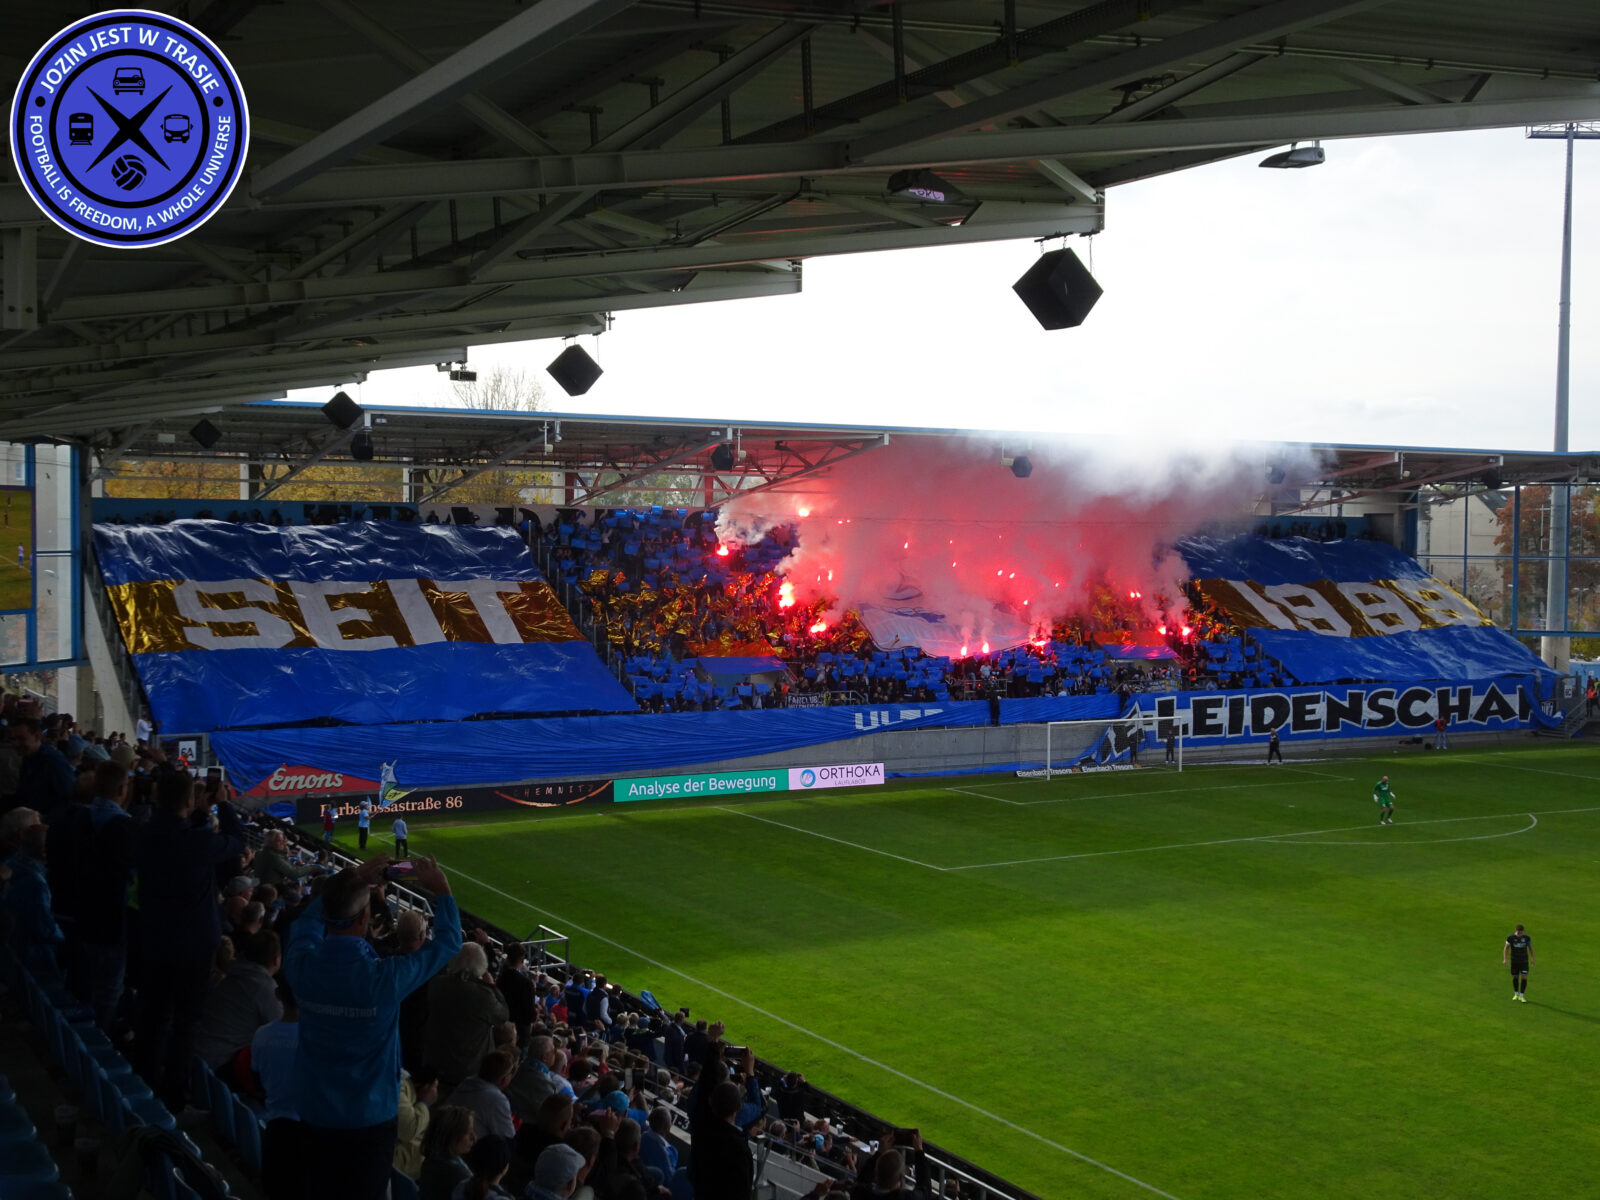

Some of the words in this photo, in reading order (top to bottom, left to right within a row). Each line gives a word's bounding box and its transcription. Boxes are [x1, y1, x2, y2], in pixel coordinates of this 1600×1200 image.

[173, 579, 525, 650] SEIT
[268, 768, 344, 791] Emons
[820, 765, 881, 780] ORTHOKA
[628, 781, 680, 797] Analyse
[683, 778, 706, 792] der
[708, 774, 777, 793] Bewegung
[320, 797, 441, 817] rbaossastraße
[445, 796, 463, 808] 86
